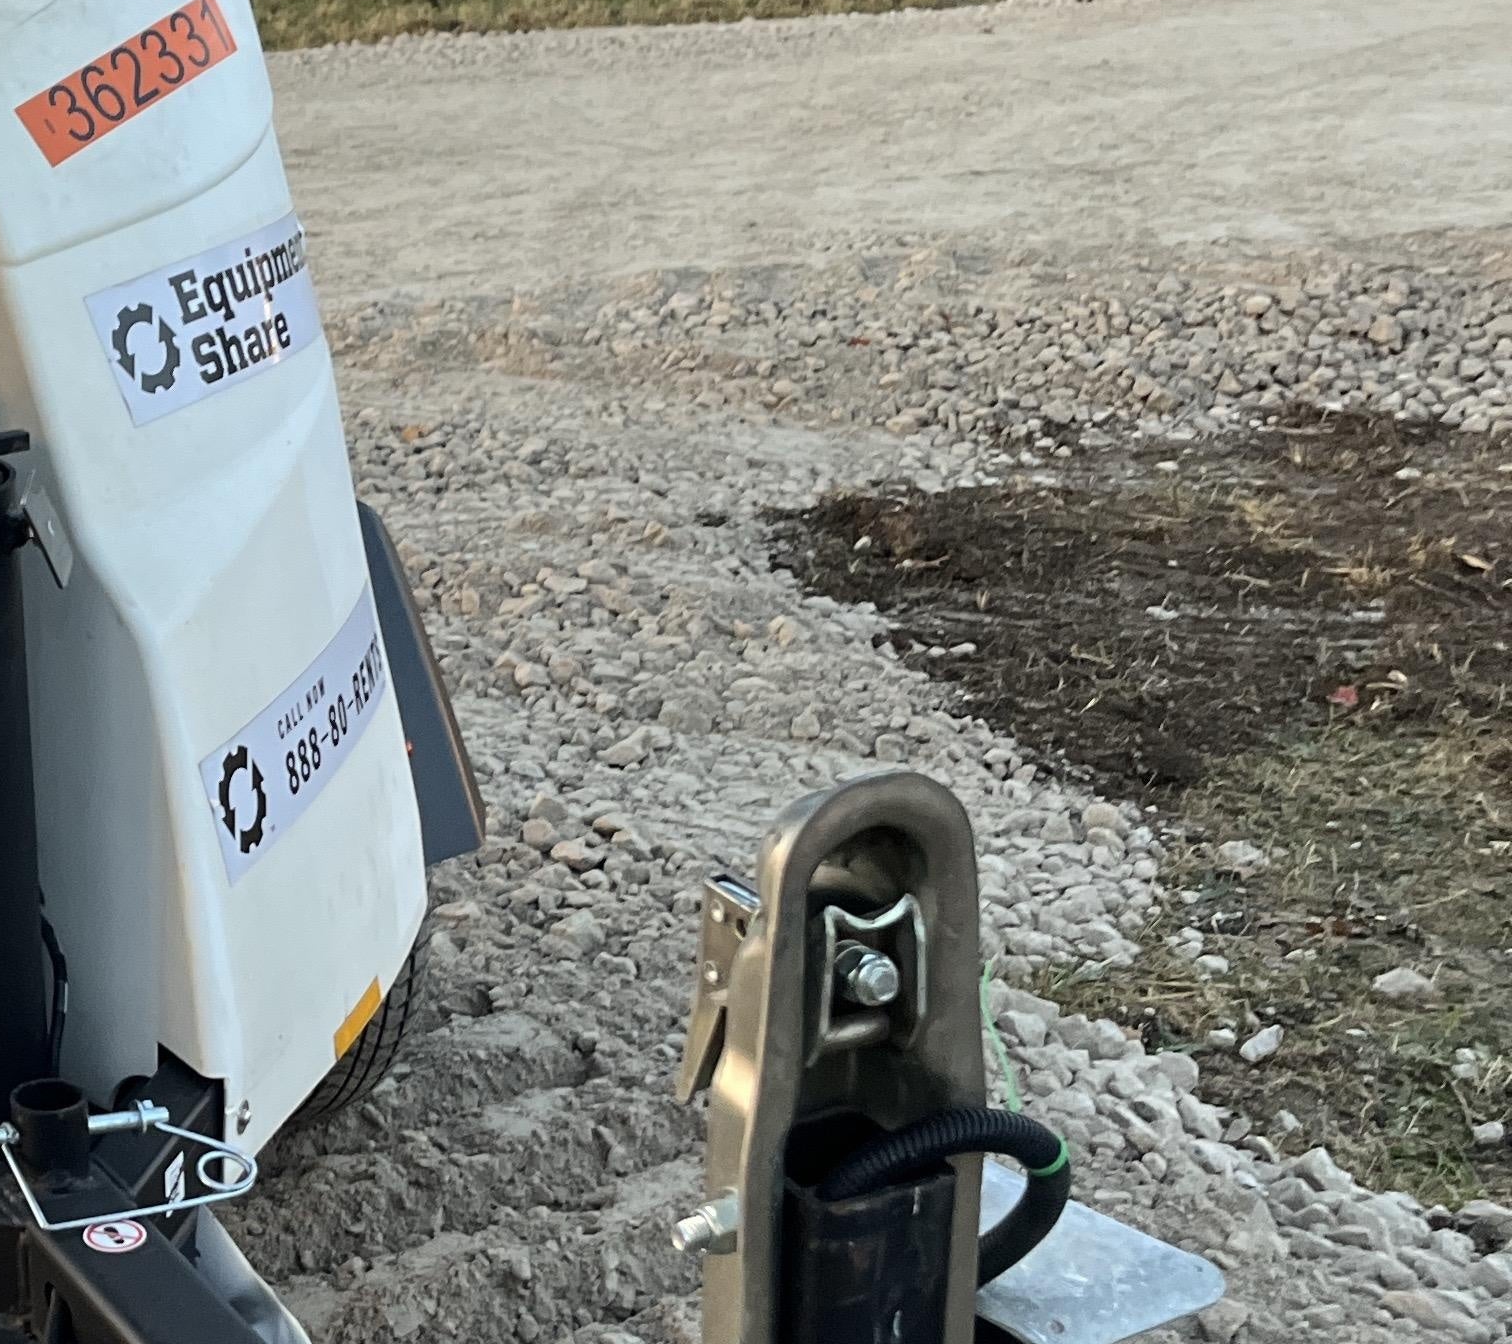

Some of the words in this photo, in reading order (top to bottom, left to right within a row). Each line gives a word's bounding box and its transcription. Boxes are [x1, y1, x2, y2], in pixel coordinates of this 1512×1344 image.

[191, 312, 291, 384] Share
[277, 702, 303, 740] CALL
[306, 675, 325, 712] NOW
